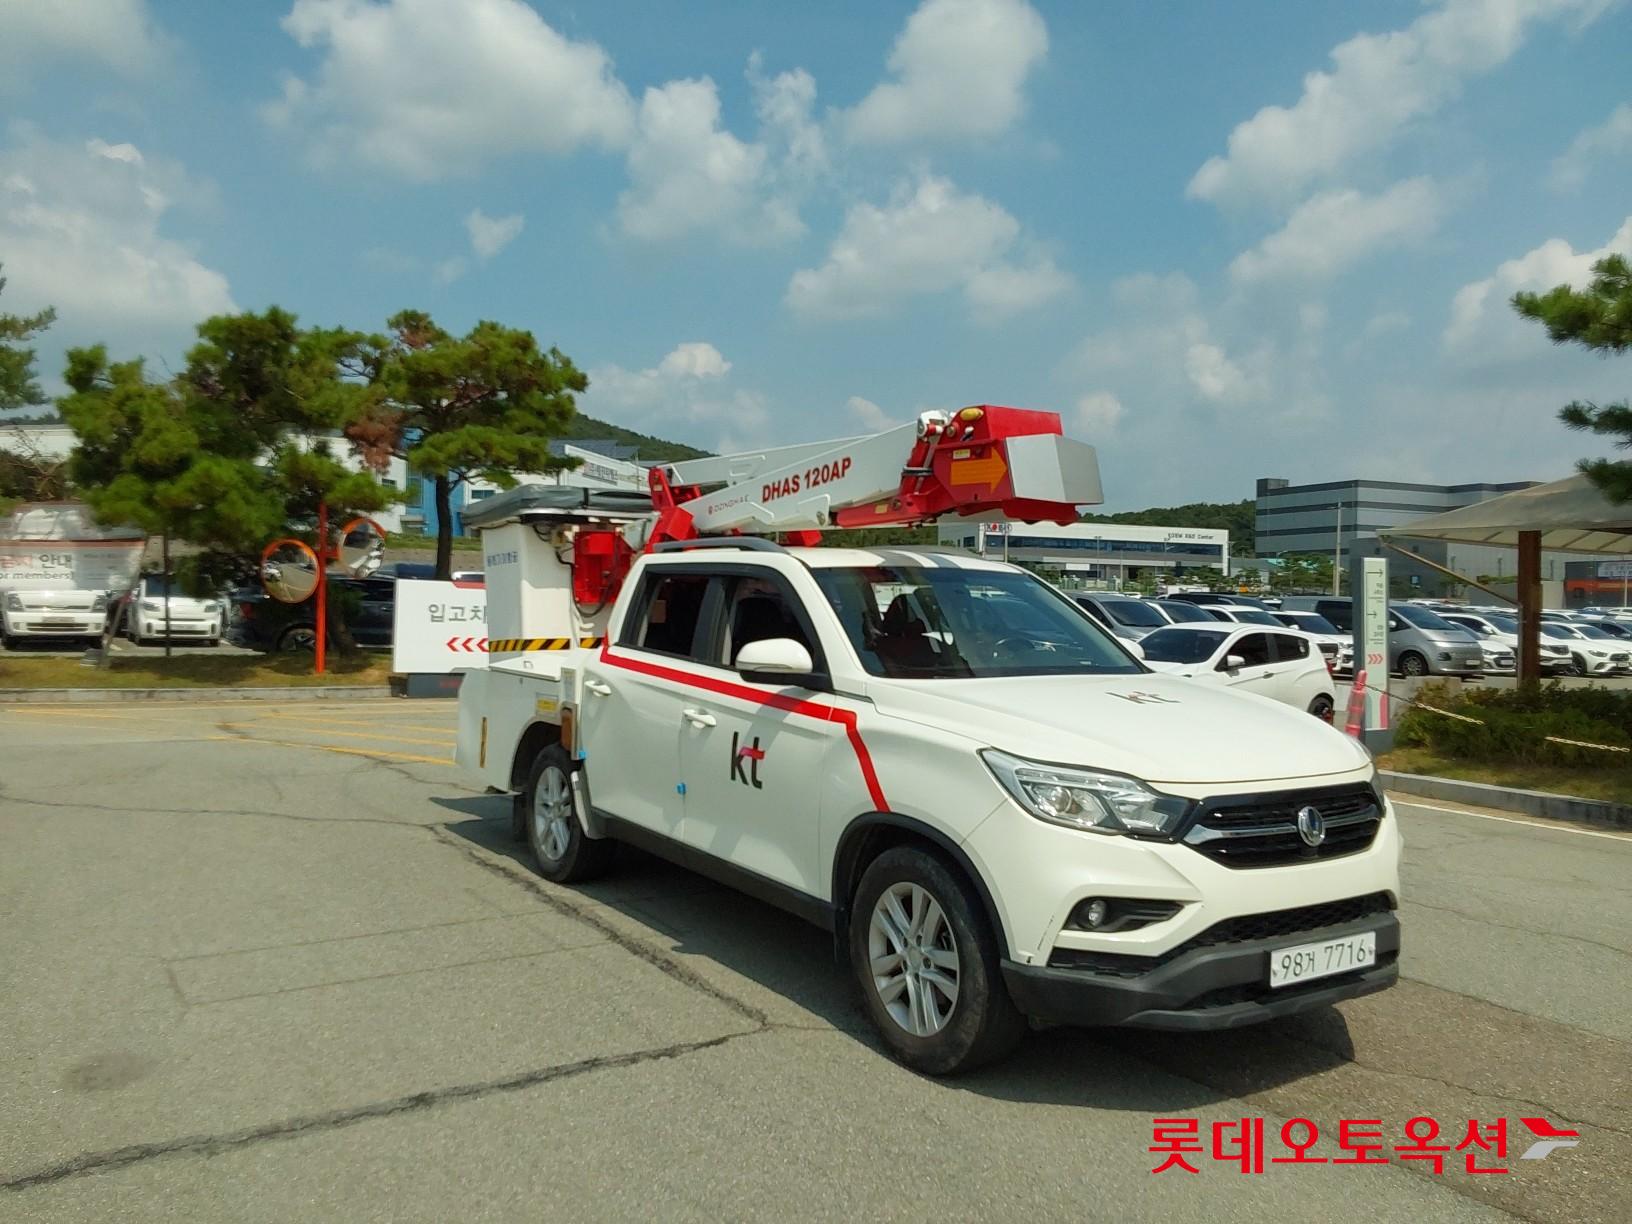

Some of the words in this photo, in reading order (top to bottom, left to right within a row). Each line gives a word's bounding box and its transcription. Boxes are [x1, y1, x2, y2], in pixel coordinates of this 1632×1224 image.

[762, 475, 801, 503] DHAS
[804, 456, 852, 489] 120AP
[39, 554, 73, 569] 안내
[730, 731, 766, 789] kt
[1281, 951, 1315, 980] 98거
[1324, 939, 1367, 971] 7716
